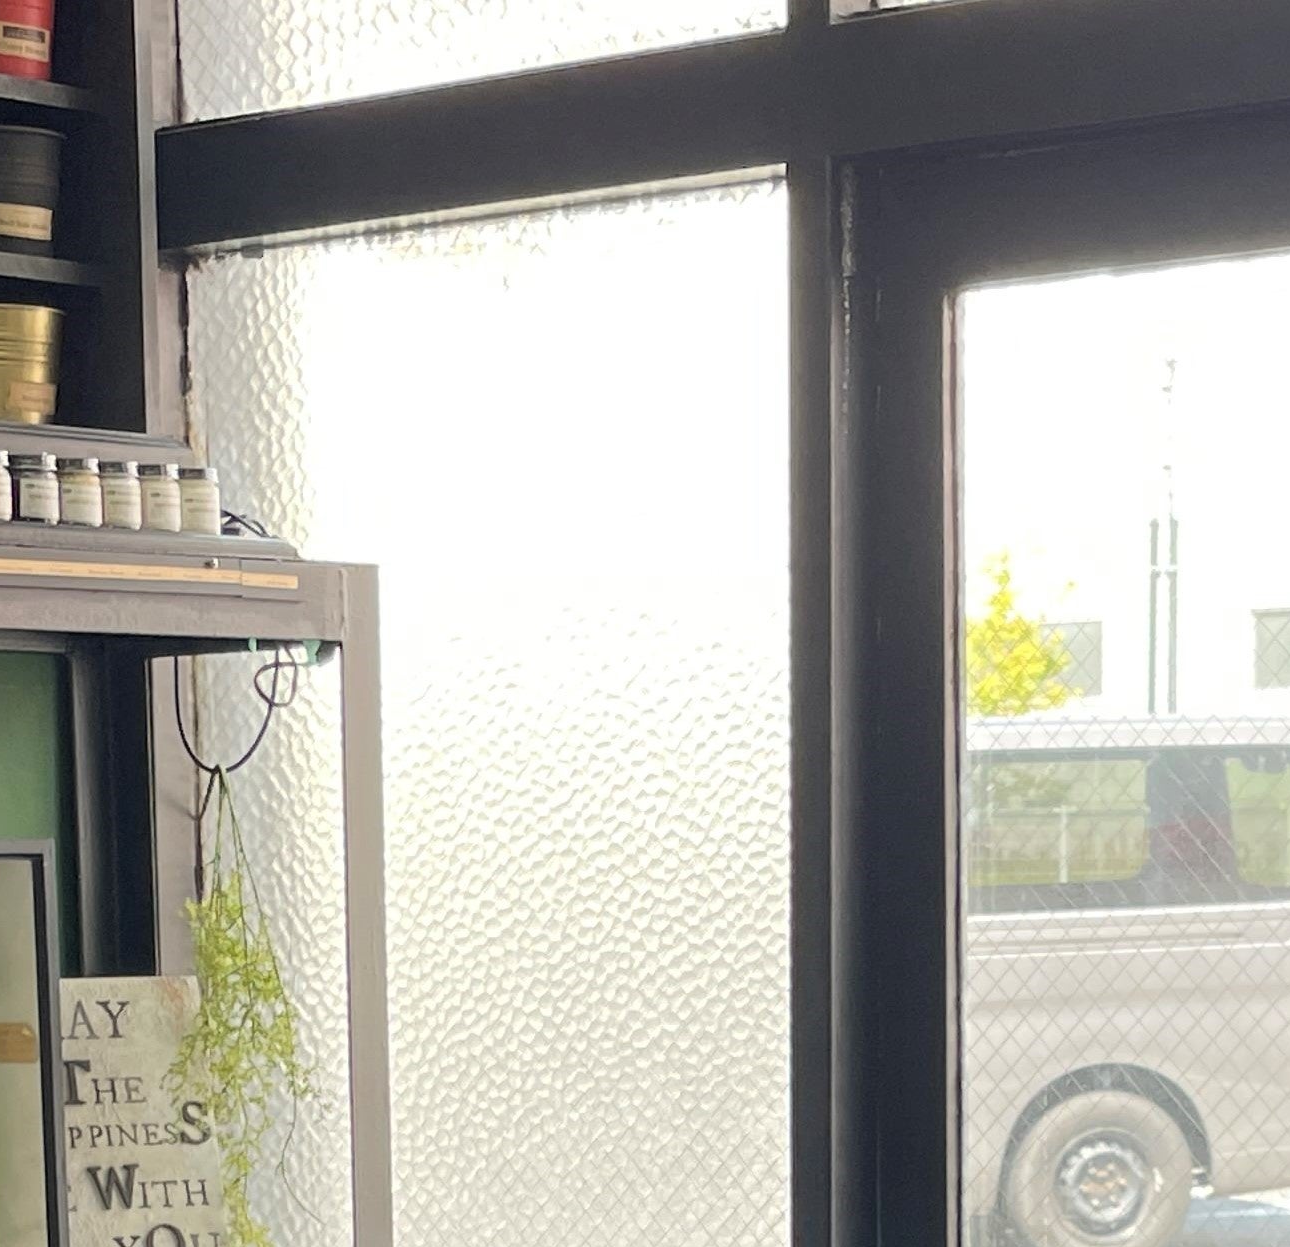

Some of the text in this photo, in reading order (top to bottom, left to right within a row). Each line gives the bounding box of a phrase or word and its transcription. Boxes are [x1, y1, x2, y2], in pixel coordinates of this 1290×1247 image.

[61, 1000, 130, 1040] AY
[63, 1060, 147, 1105] THE
[87, 1164, 210, 1210] WITH
